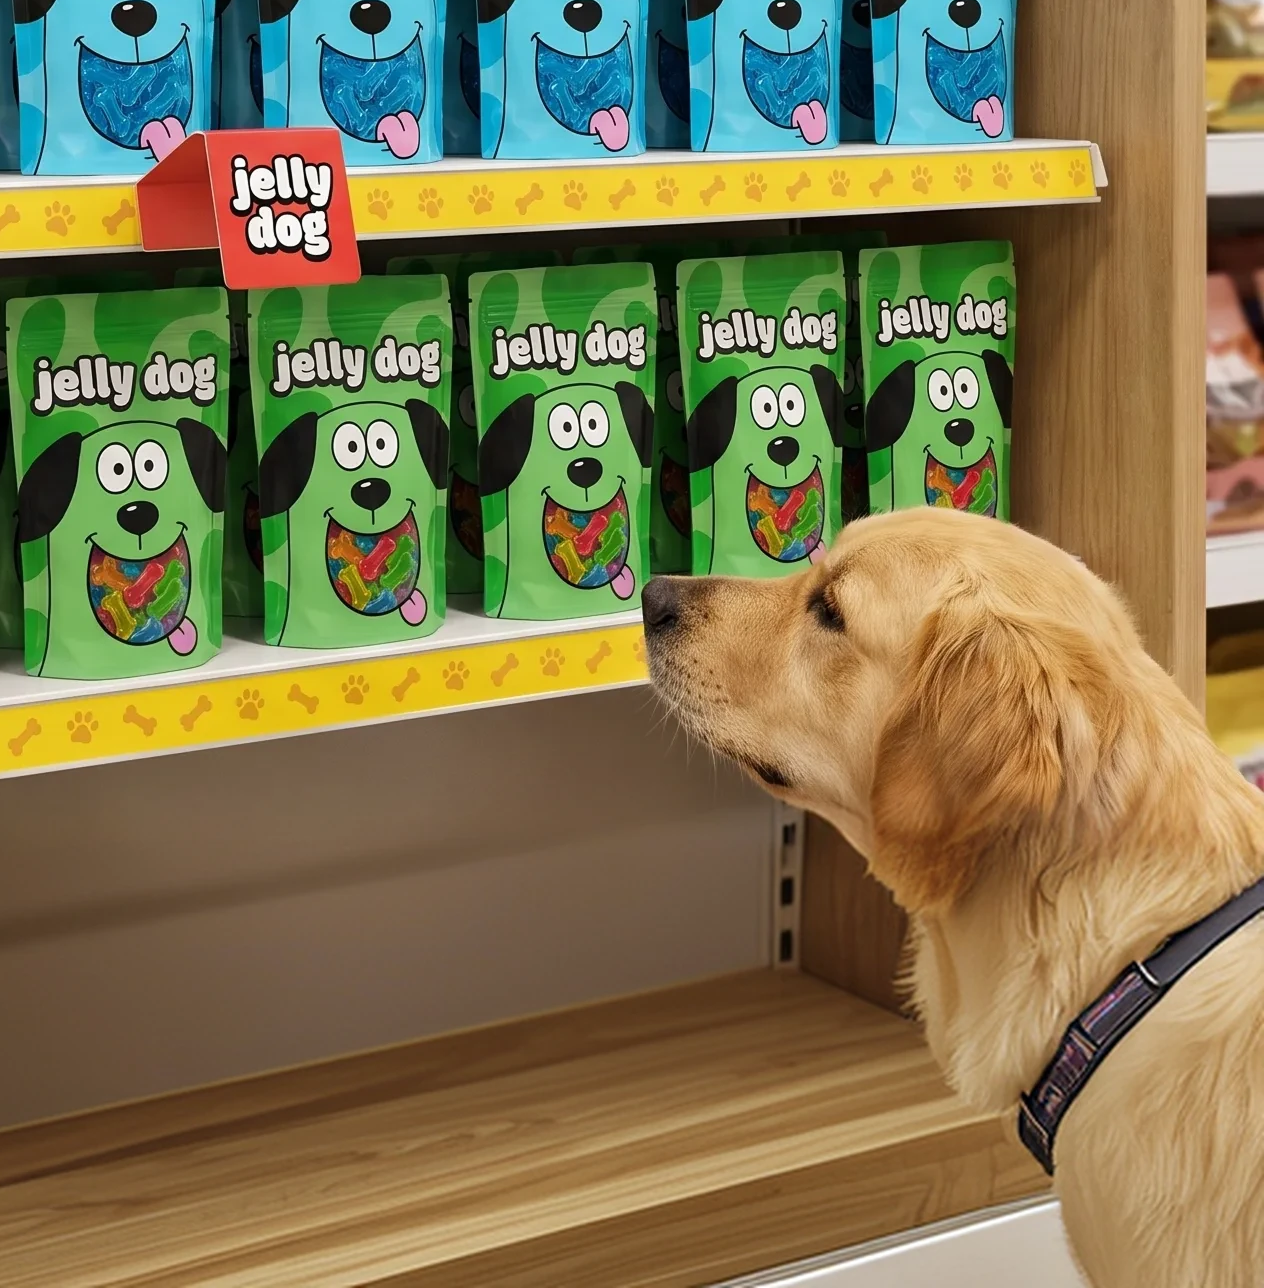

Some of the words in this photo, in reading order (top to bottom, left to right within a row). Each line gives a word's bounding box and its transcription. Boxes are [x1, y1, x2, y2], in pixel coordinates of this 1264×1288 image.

[230, 154, 333, 210] jelly
[244, 203, 332, 258] dog
[697, 308, 778, 360] jelly
[781, 306, 839, 352] dog
[876, 295, 952, 345] jelly
[954, 293, 1009, 337] dog
[271, 338, 367, 395] jelly
[372, 336, 442, 385] dog
[491, 323, 579, 377] jelly
[583, 320, 648, 368] dog
[32, 355, 137, 413] jelly
[141, 352, 218, 403] dog
